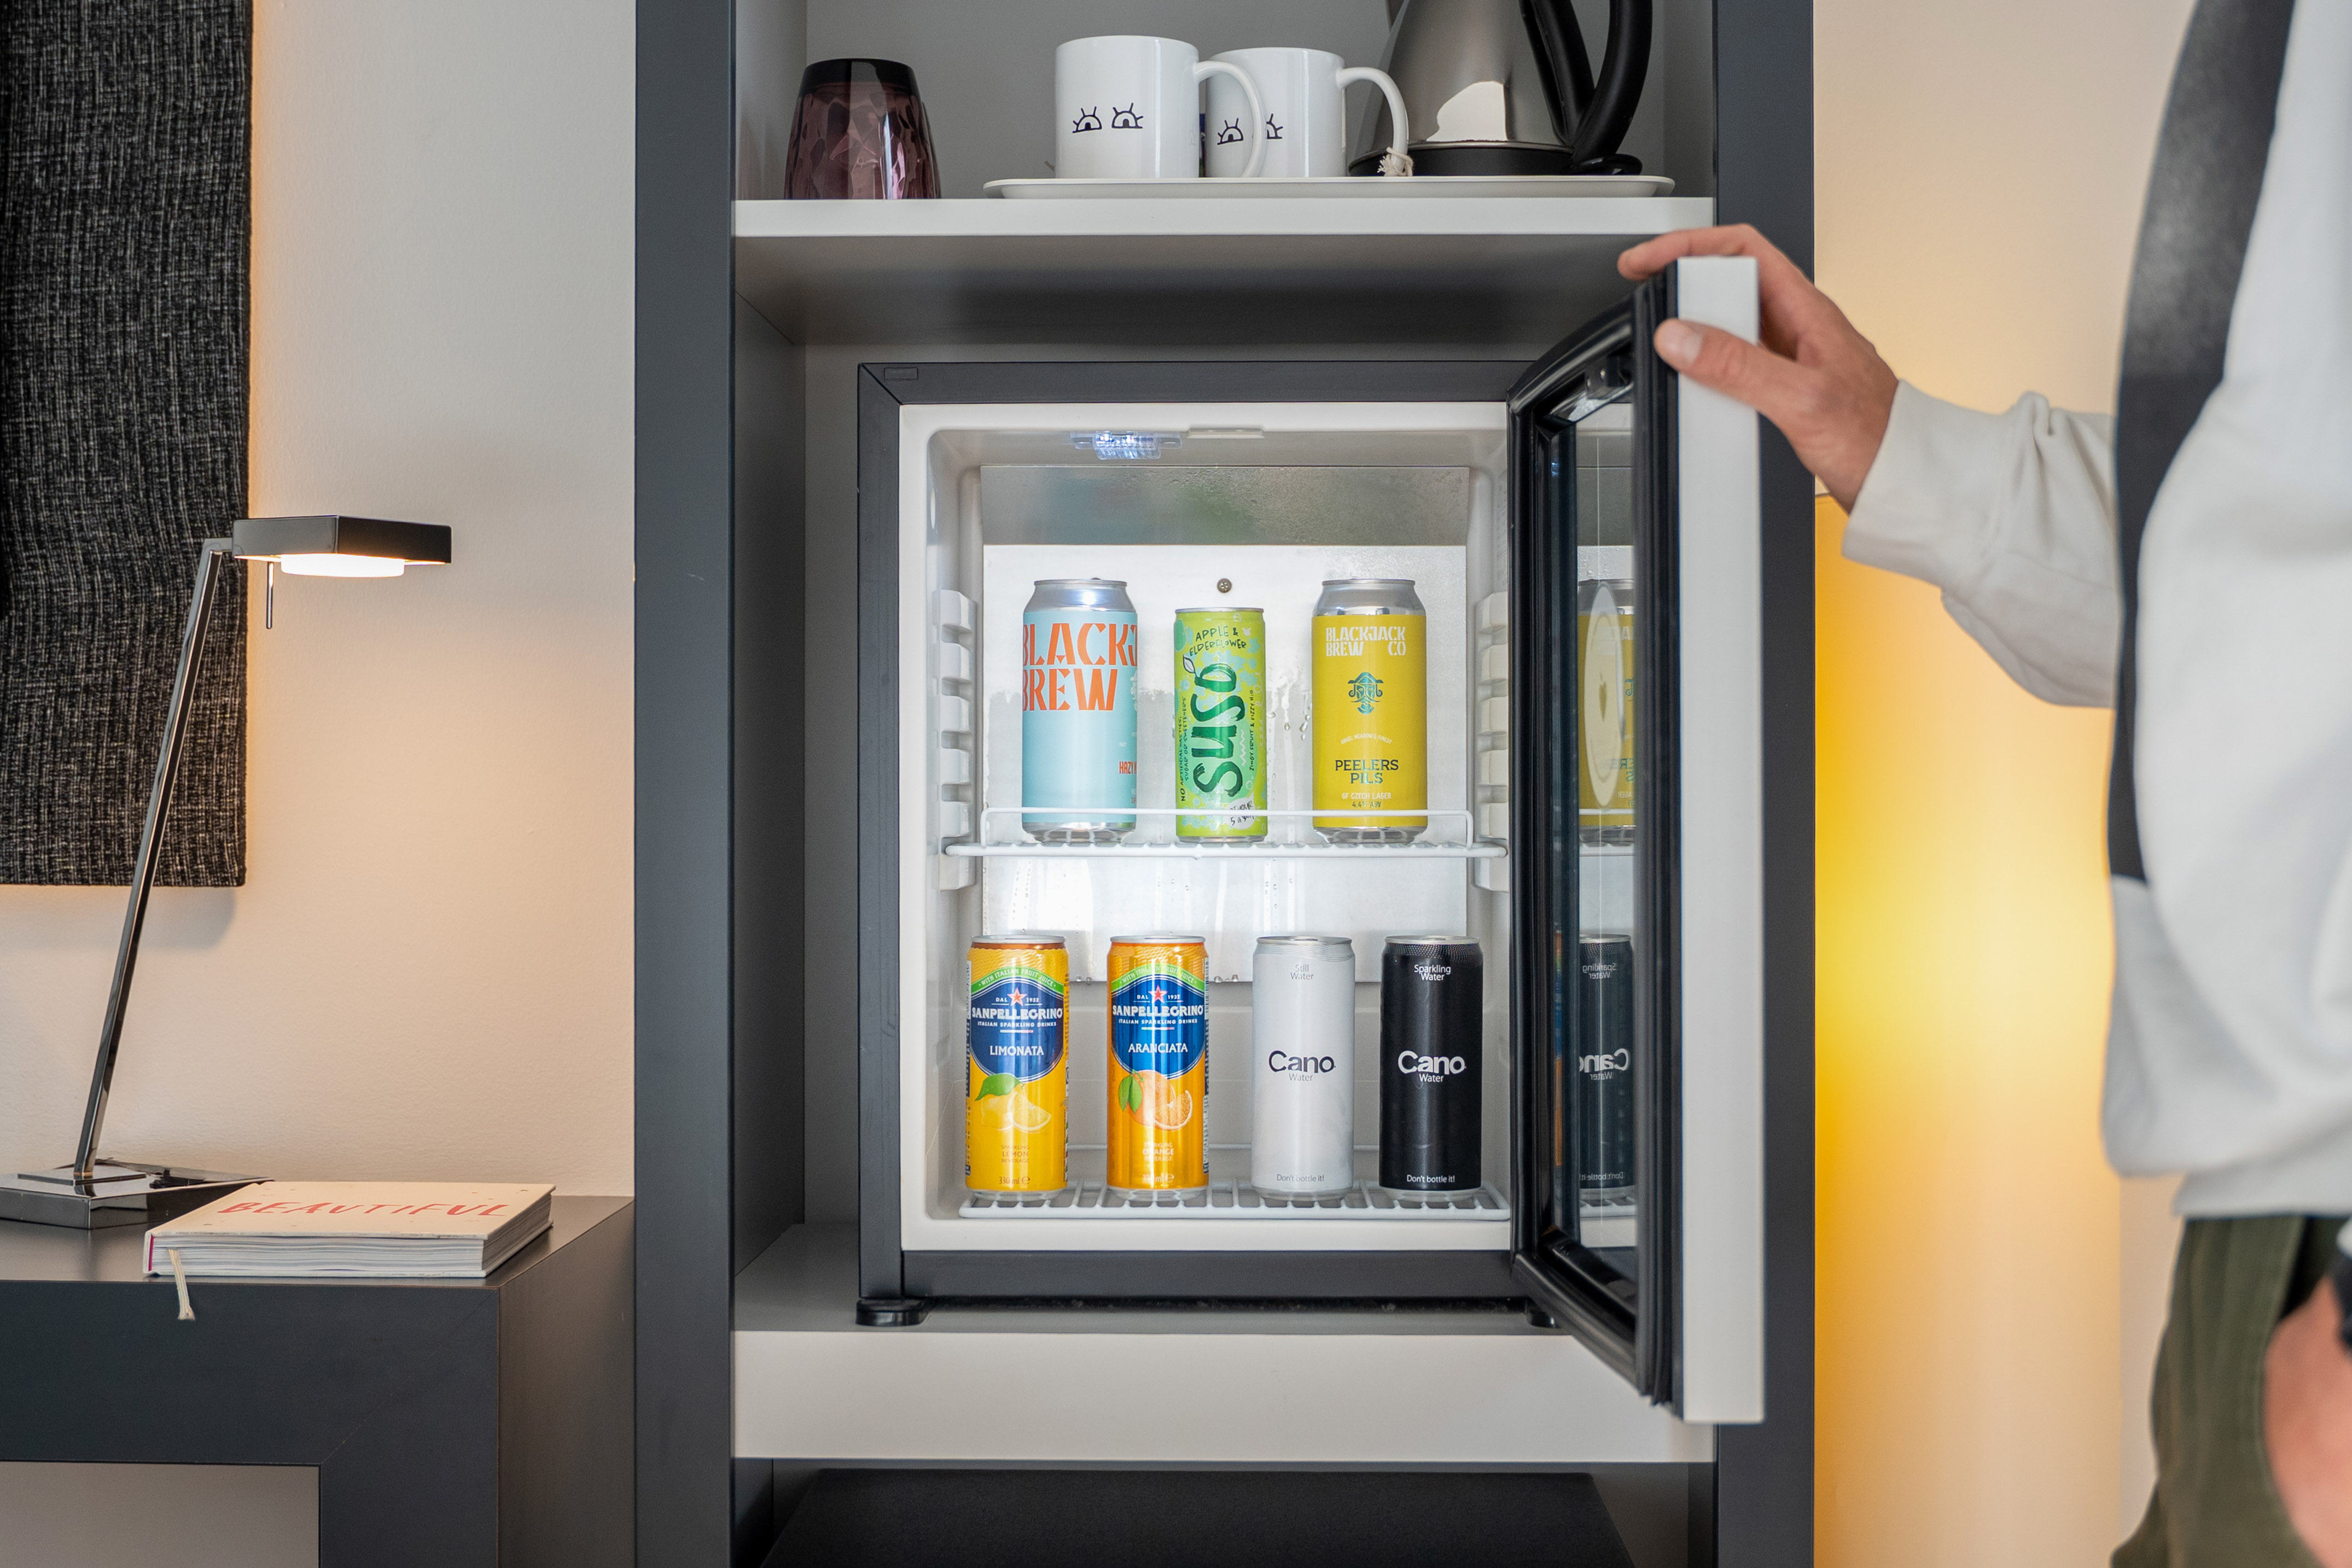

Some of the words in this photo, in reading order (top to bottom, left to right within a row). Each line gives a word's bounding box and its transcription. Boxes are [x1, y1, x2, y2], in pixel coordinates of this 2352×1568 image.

[1196, 626, 1228, 642] APPLE
[1233, 627, 1238, 636] &
[1326, 626, 1406, 642] BLACKJACK
[1189, 639, 1246, 656] ELDERFLOWER
[1326, 642, 1364, 656] BREW
[1388, 641, 1406, 656] CO
[1023, 668, 1117, 711] BREW
[1184, 744, 1188, 754] OR
[1335, 759, 1399, 771] PEELERS
[1350, 772, 1383, 784] PILS
[1180, 788, 1185, 801] NO
[1230, 817, 1235, 826] 5
[1414, 964, 1451, 975] Sparkling
[981, 976, 994, 985] WITH
[995, 969, 1019, 978] ITALIAN
[1021, 969, 1039, 978] FRUIT
[1039, 975, 1053, 987] JUICE
[1122, 973, 1135, 982] WITH
[1290, 972, 1314, 980] Water
[971, 1007, 1063, 1020] SANPELLEGRINO
[1113, 1005, 1203, 1017] SANPELLEGRINO
[989, 1045, 1044, 1056] LIMONATA
[1128, 1043, 1188, 1053] ARANCIATA
[1268, 1050, 1335, 1074] Cano
[1398, 1050, 1465, 1075] Cano
[1289, 1073, 1313, 1081] Water
[1419, 1074, 1444, 1082] Water
[999, 1176, 1010, 1185] 330
[1407, 1174, 1425, 1182] Don't
[1427, 1175, 1447, 1183] bottle
[217, 1202, 509, 1216] BEAUTIFUL
